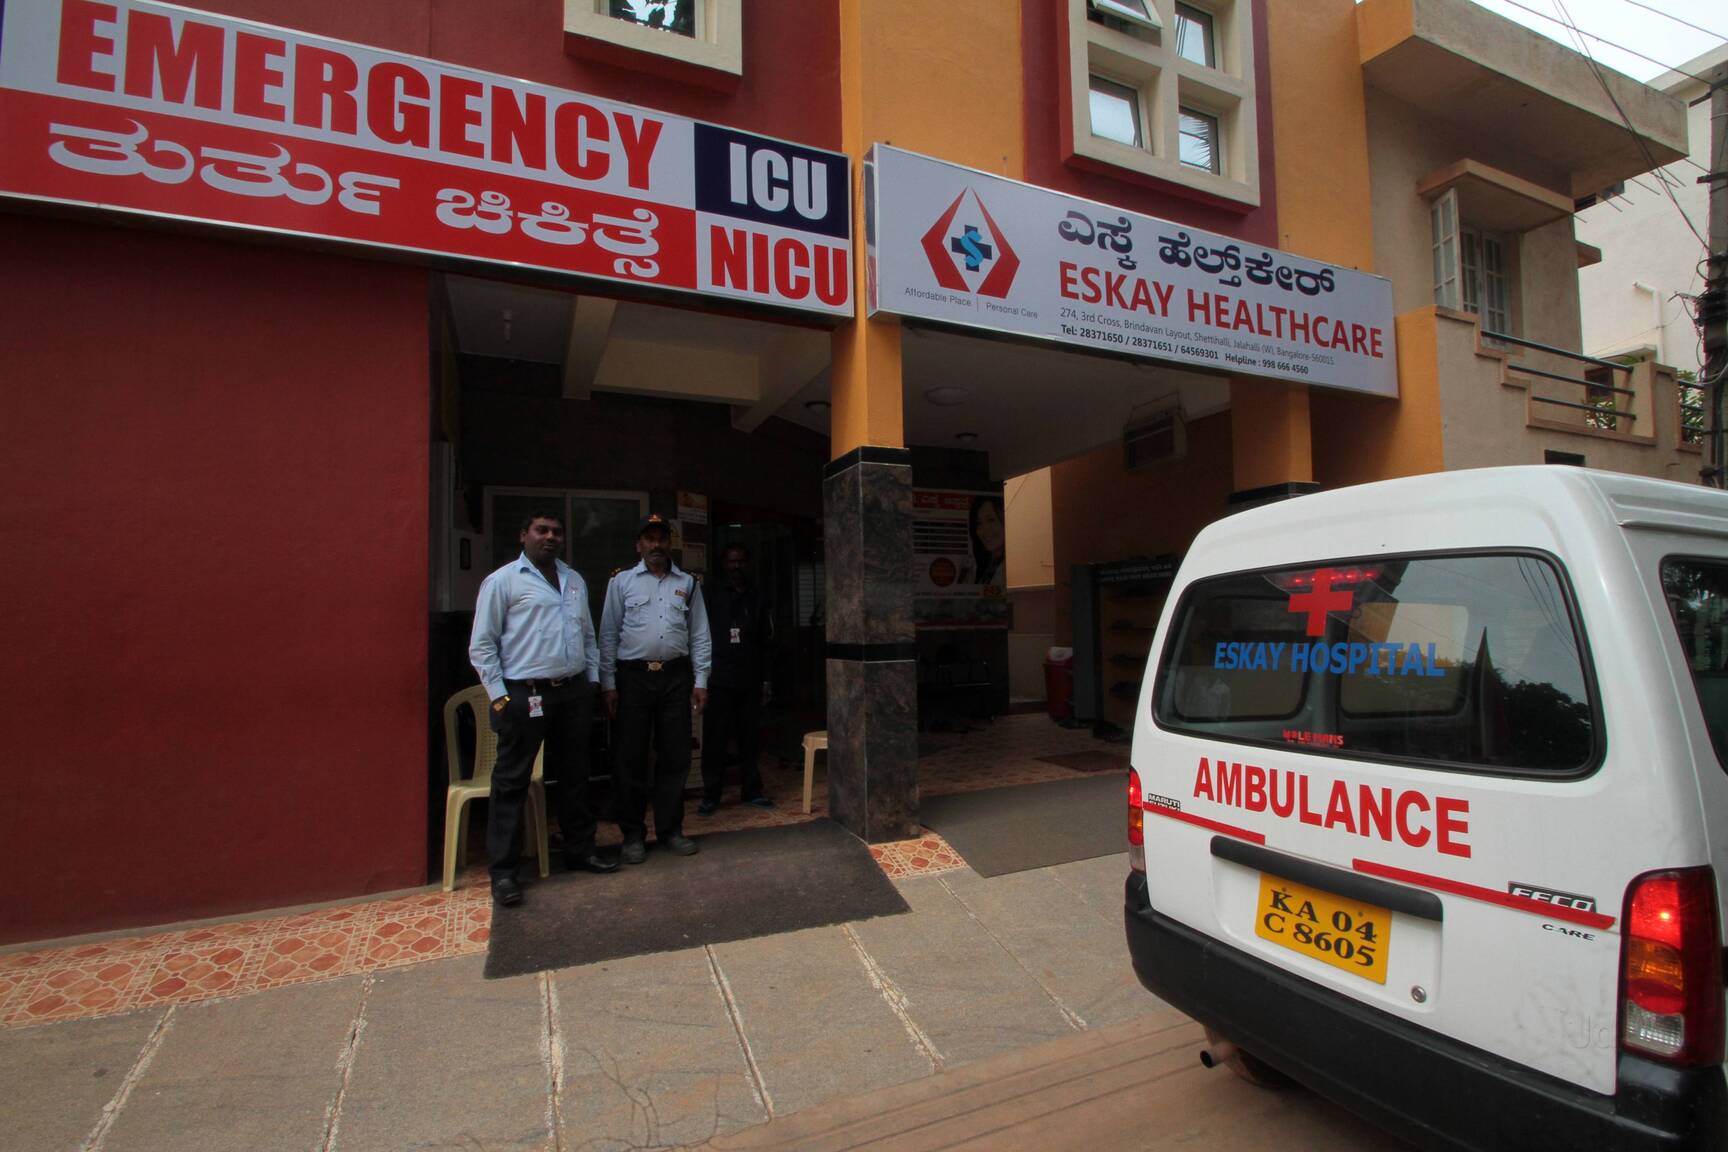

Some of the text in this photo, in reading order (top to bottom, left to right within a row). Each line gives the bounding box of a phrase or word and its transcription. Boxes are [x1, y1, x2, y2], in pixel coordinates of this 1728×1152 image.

[57, 0, 663, 191] EMERGENCY
[48, 118, 661, 279] ತುರ್ತು ಚಿಕಿತ್ಸೆ
[729, 142, 828, 220] ICU
[710, 224, 848, 307] NICU
[904, 287, 972, 307] Affordable Place
[985, 302, 1039, 320] Personal Care
[1059, 260, 1384, 359] ESKAY HEALTHCARE
[1060, 307, 1079, 320] 274,
[1081, 311, 1096, 323] 3rd
[1097, 315, 1122, 329] Cross,
[1124, 319, 1163, 335] Brindavan
[1165, 327, 1191, 341] Layout,
[1060, 323, 1078, 336] Tel:
[1080, 327, 1124, 344] 28371650
[1132, 336, 1173, 352] 28371651
[1180, 345, 1219, 360] 64569301
[1262, 359, 1276, 370] 998
[1214, 641, 1447, 678] ESKAY HOSPITAL
[1148, 793, 1181, 809] MARUTI
[1193, 756, 1472, 859] AMBULANCE
[1263, 912, 1377, 967] C 8605
[1269, 889, 1378, 944] KA 04
[1541, 923, 1596, 942] CARE
